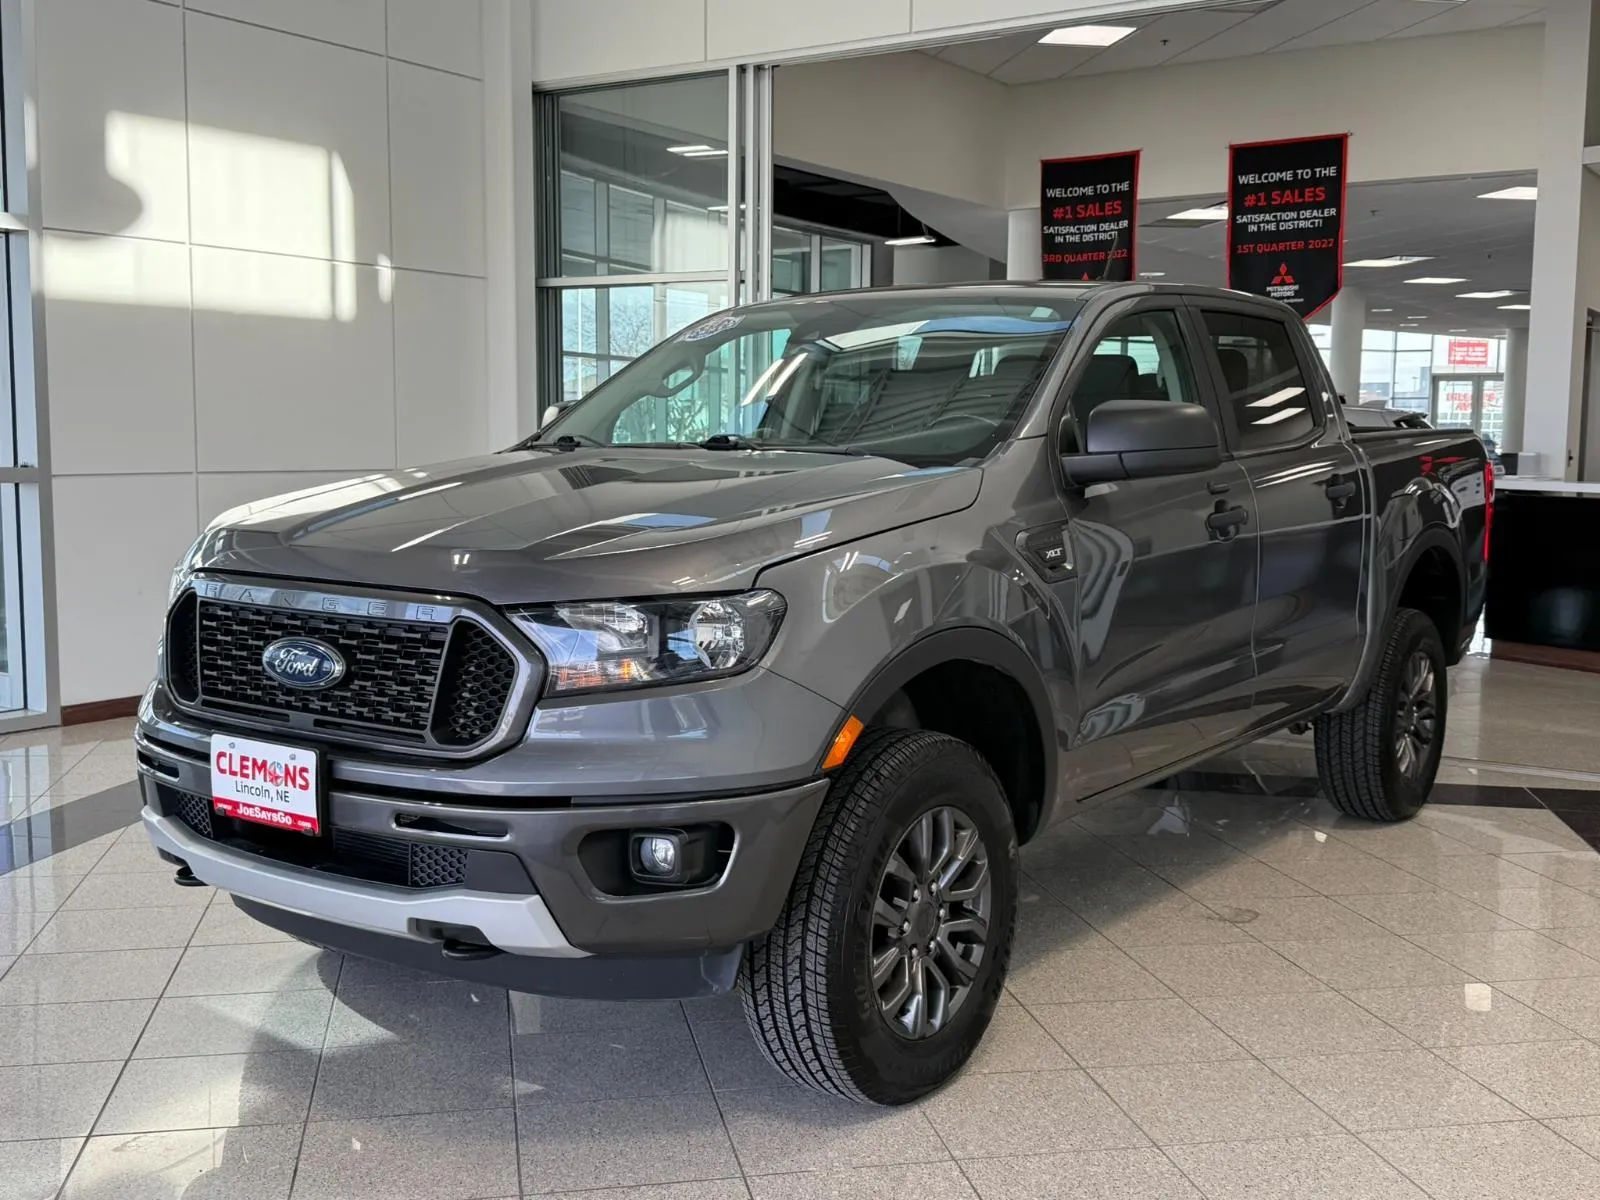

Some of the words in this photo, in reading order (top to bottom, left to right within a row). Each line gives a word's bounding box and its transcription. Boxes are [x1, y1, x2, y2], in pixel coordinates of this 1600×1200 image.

[1238, 170, 1293, 185] WELCOME
[1296, 169, 1311, 179] TO
[1314, 166, 1337, 178] THE
[1046, 185, 1094, 198] WELCOME
[1097, 184, 1109, 194] TO
[1111, 181, 1130, 192] THE
[1244, 192, 1267, 208] #1
[1271, 186, 1326, 205] SALES
[1052, 205, 1073, 219] #1
[1076, 200, 1122, 218] SALES
[1236, 210, 1297, 224] SATISFACTION
[1300, 208, 1337, 219] DEALER
[1043, 223, 1098, 234] SATISFACTION
[1099, 220, 1129, 231] DEALER
[1248, 224, 1257, 232] IN
[1260, 222, 1277, 231] THE
[1279, 219, 1323, 230] DISTRICT!
[1054, 235, 1064, 243] IN
[1066, 234, 1080, 243] THE
[1236, 243, 1255, 254] 1ST
[1257, 241, 1305, 253] QUARTER
[1308, 238, 1335, 249] 2022
[1043, 254, 1062, 263] 3RD
[1063, 252, 1105, 264] QUARTER
[1046, 547, 1063, 559] XLT
[205, 583, 436, 621] RANGER
[275, 648, 320, 677] Ford
[216, 751, 310, 791] CLEMONS
[235, 780, 274, 803] Lincoln,
[276, 789, 290, 803] NE
